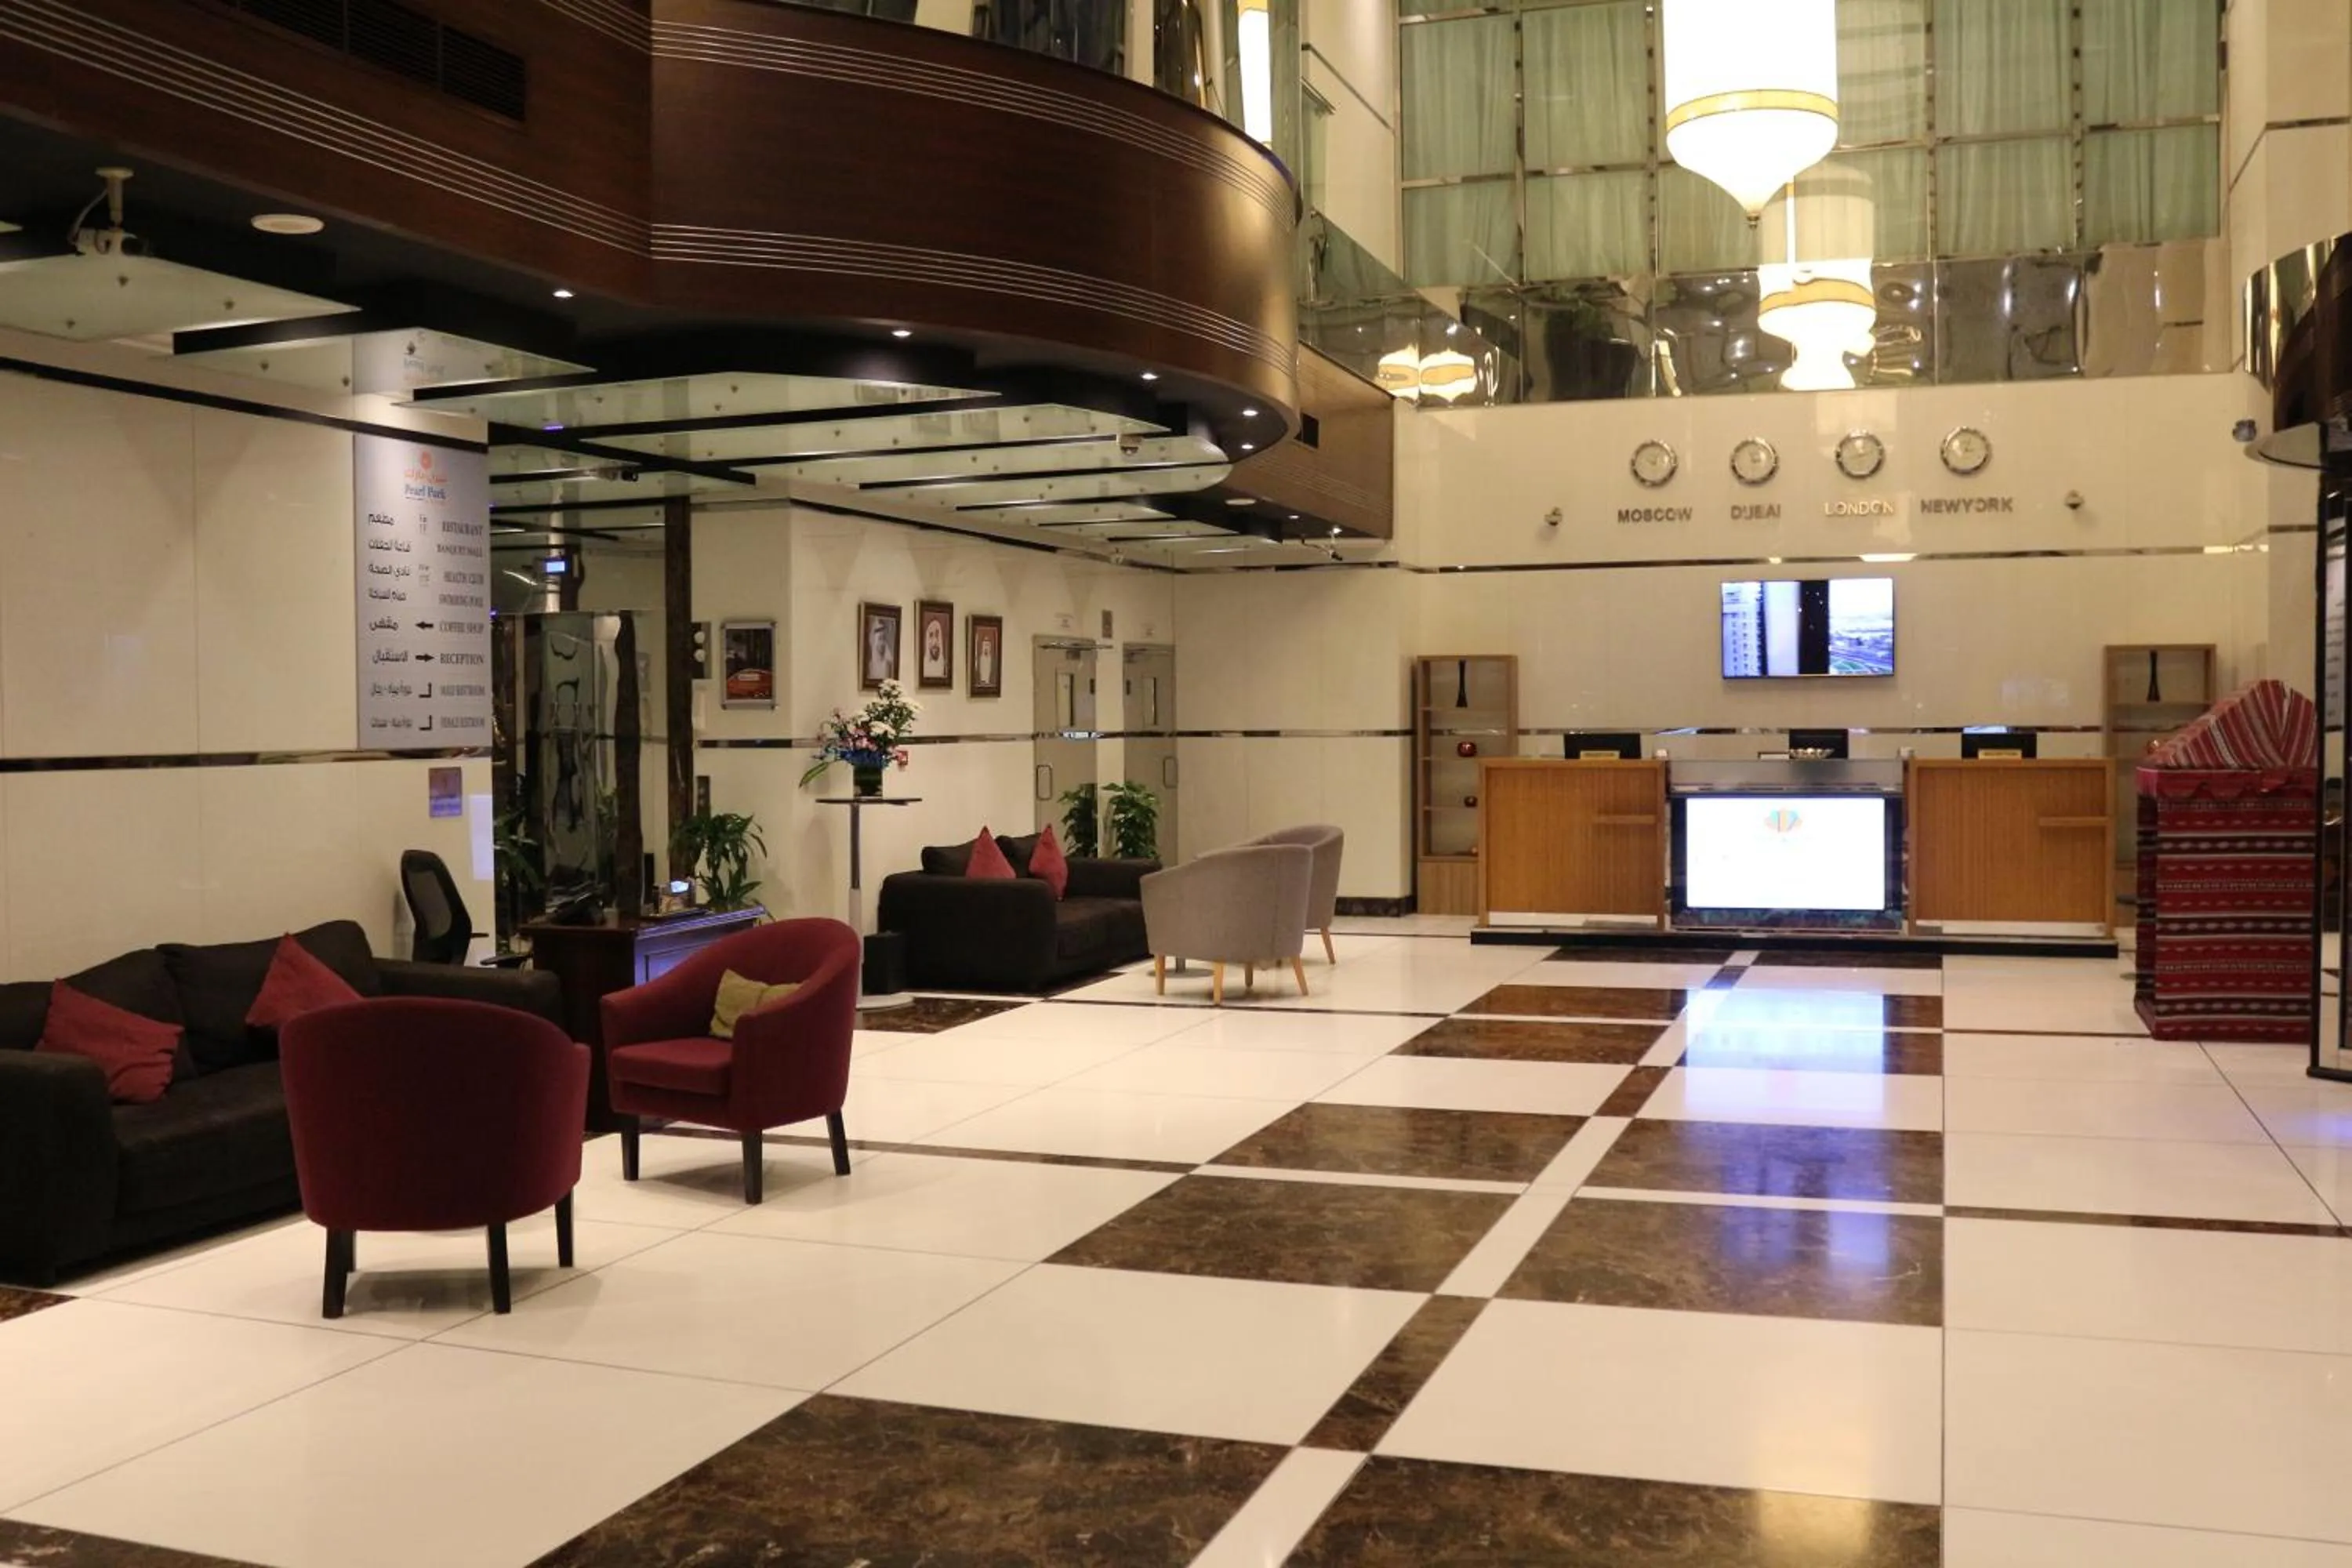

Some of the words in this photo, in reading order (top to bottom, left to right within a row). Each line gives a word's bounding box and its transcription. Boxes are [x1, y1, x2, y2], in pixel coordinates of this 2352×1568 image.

[405, 485, 426, 496] Pearl
[427, 486, 447, 499] Park
[1824, 499, 1895, 517] LONDON
[1920, 496, 2014, 514] NEWYORK
[1617, 507, 1693, 524] MOSCOW
[441, 653, 485, 665] RECEPTION
